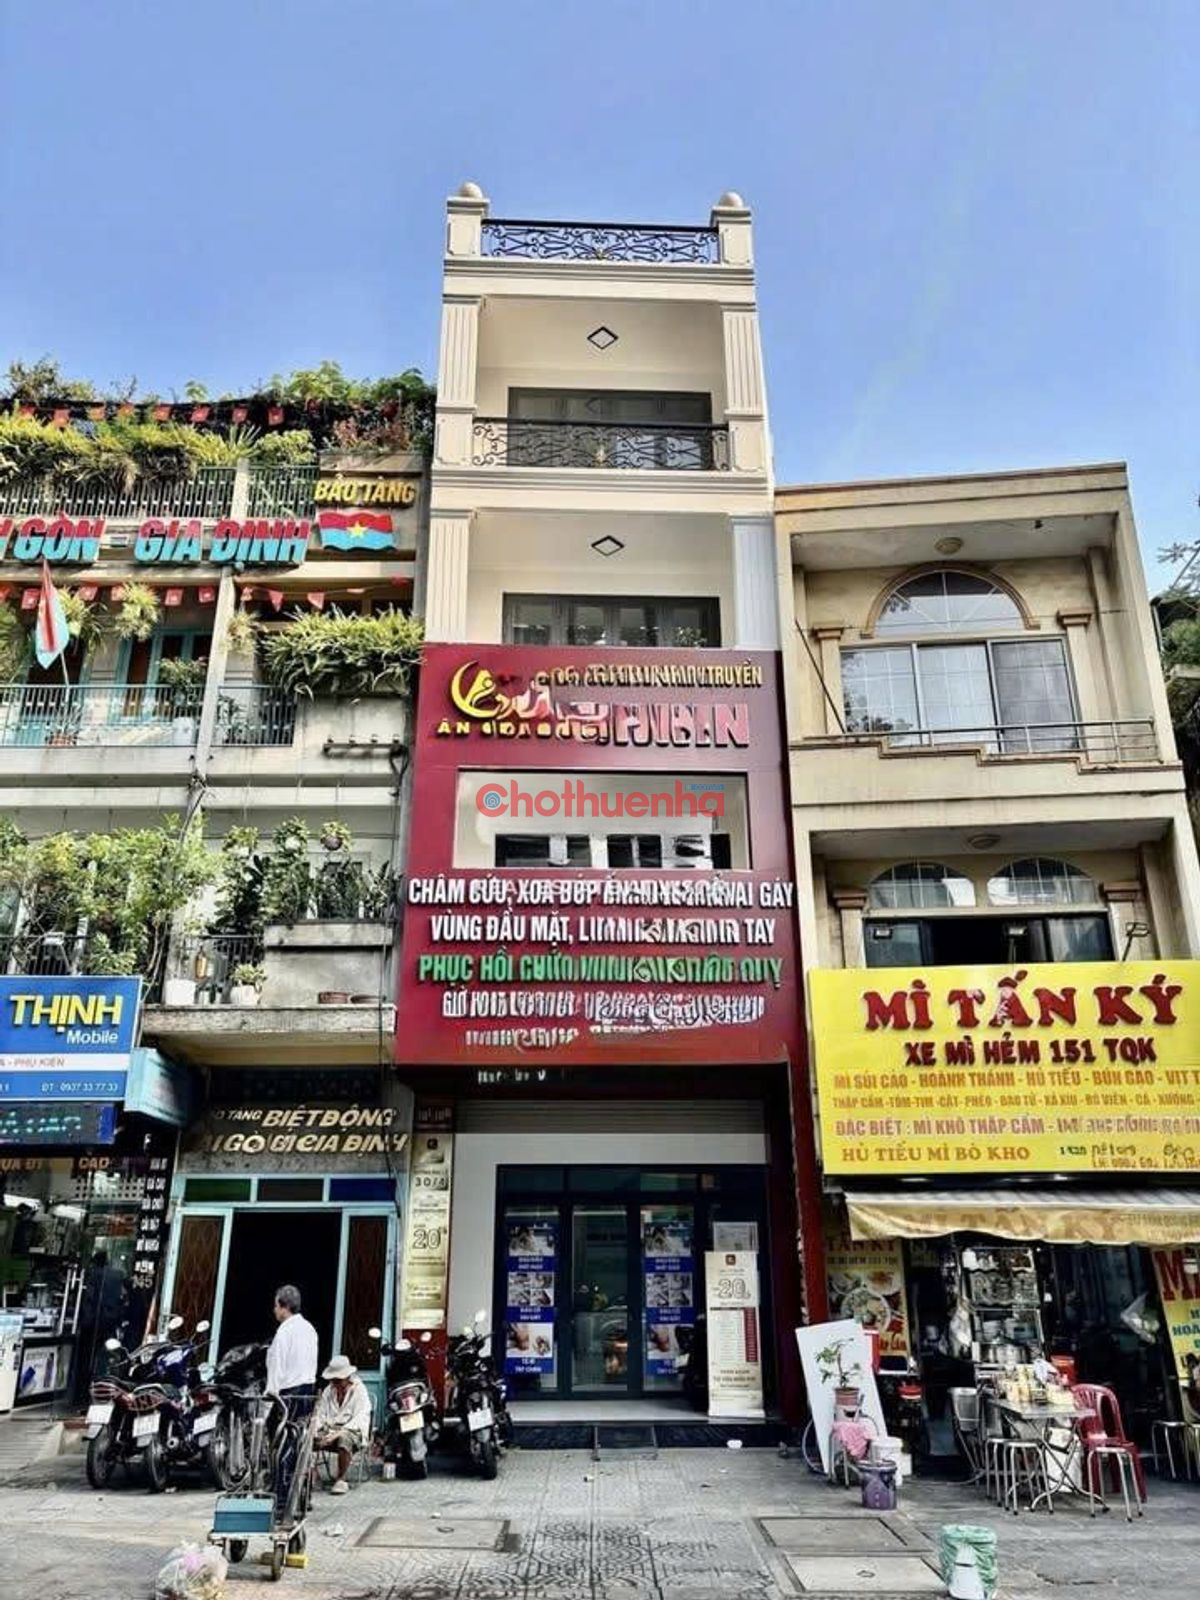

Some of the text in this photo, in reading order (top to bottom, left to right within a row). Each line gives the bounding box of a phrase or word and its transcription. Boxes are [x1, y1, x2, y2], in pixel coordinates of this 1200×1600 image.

[134, 517, 203, 562] GIA
[409, 874, 465, 905] CHÂM
[430, 909, 482, 942] VÙNG
[486, 907, 526, 942] ĐẦU
[745, 918, 776, 944] TAY
[419, 954, 474, 987] PHỤC
[480, 946, 513, 981] HỒI
[9, 994, 124, 1033] THỊNH
[863, 978, 934, 1031] MÌ
[947, 969, 1077, 1029] TẤN
[66, 1029, 119, 1045] Mobile
[904, 1041, 937, 1067] XE
[1049, 1038, 1097, 1064] 151
[1103, 1036, 1157, 1067] TQK
[988, 1146, 1031, 1161] KHO
